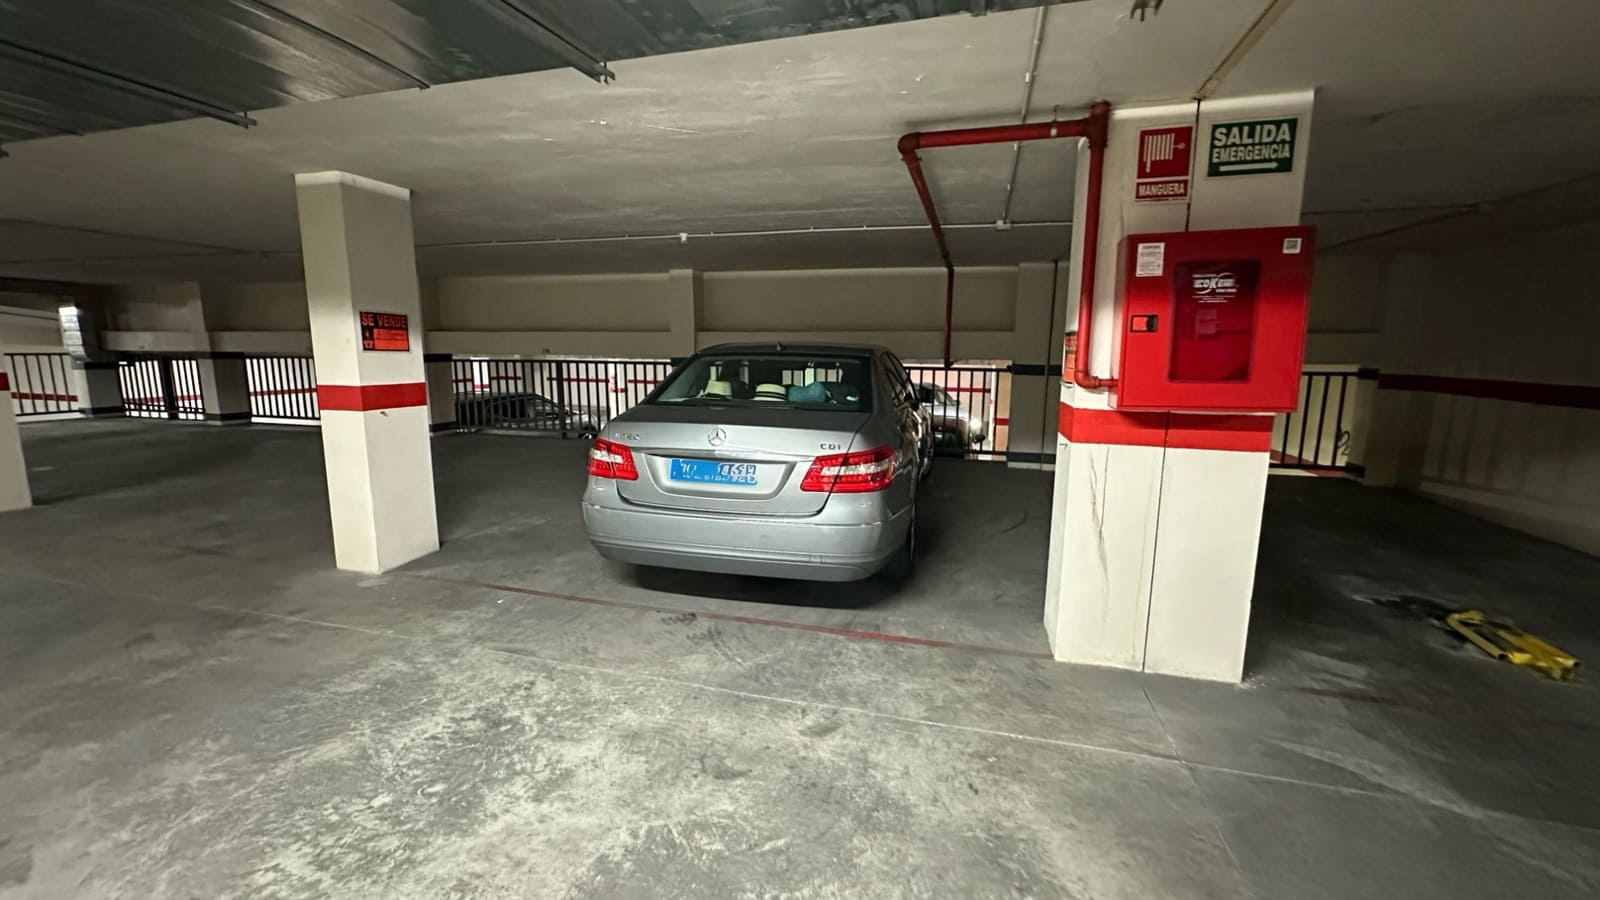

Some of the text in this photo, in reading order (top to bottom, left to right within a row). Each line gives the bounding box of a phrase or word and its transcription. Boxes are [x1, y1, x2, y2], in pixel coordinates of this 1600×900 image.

[1213, 122, 1291, 147] SALIDA
[1211, 143, 1291, 163] EMERGENCIA
[1138, 183, 1185, 197] MANGUERA
[361, 313, 407, 328] SE VENDE
